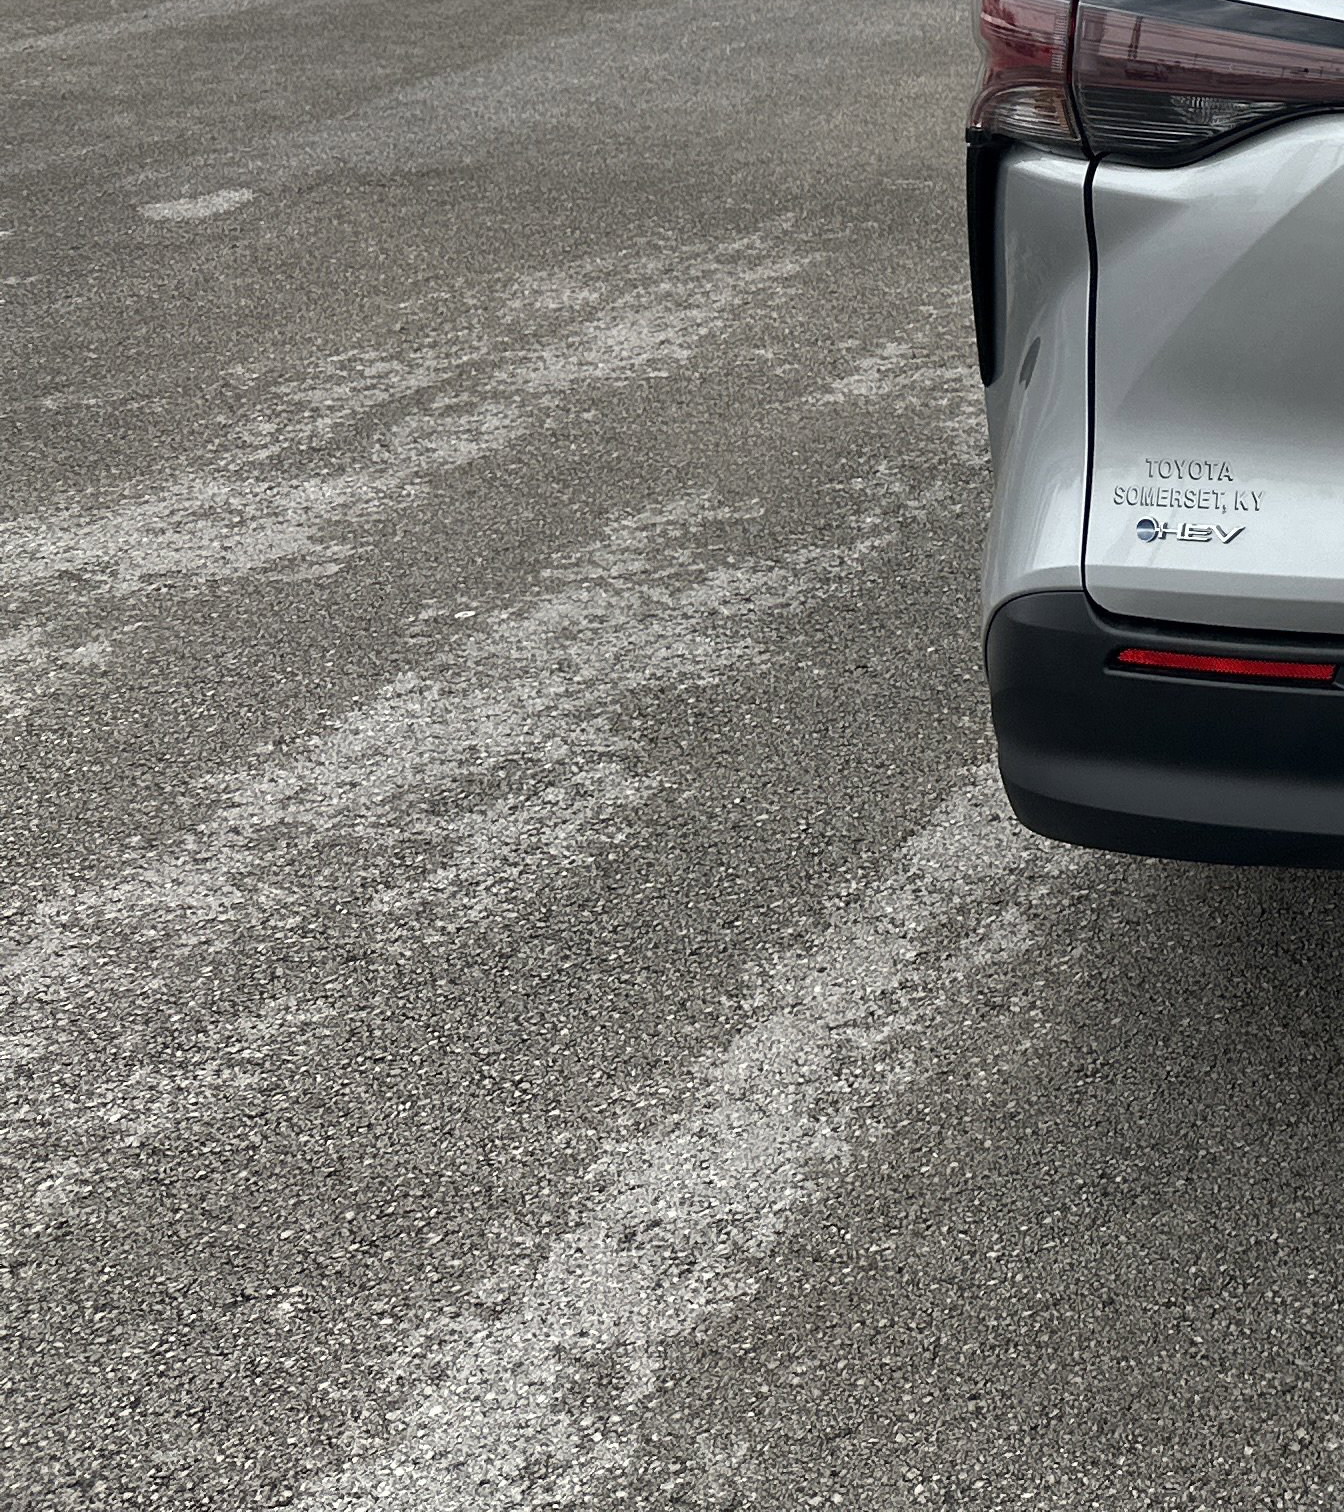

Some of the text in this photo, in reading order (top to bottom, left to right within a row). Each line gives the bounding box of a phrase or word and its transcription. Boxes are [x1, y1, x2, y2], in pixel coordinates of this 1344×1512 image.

[1146, 458, 1234, 481] TOYOTA
[1113, 485, 1263, 514] SOMERSET, KY
[1157, 521, 1246, 544] HEV
